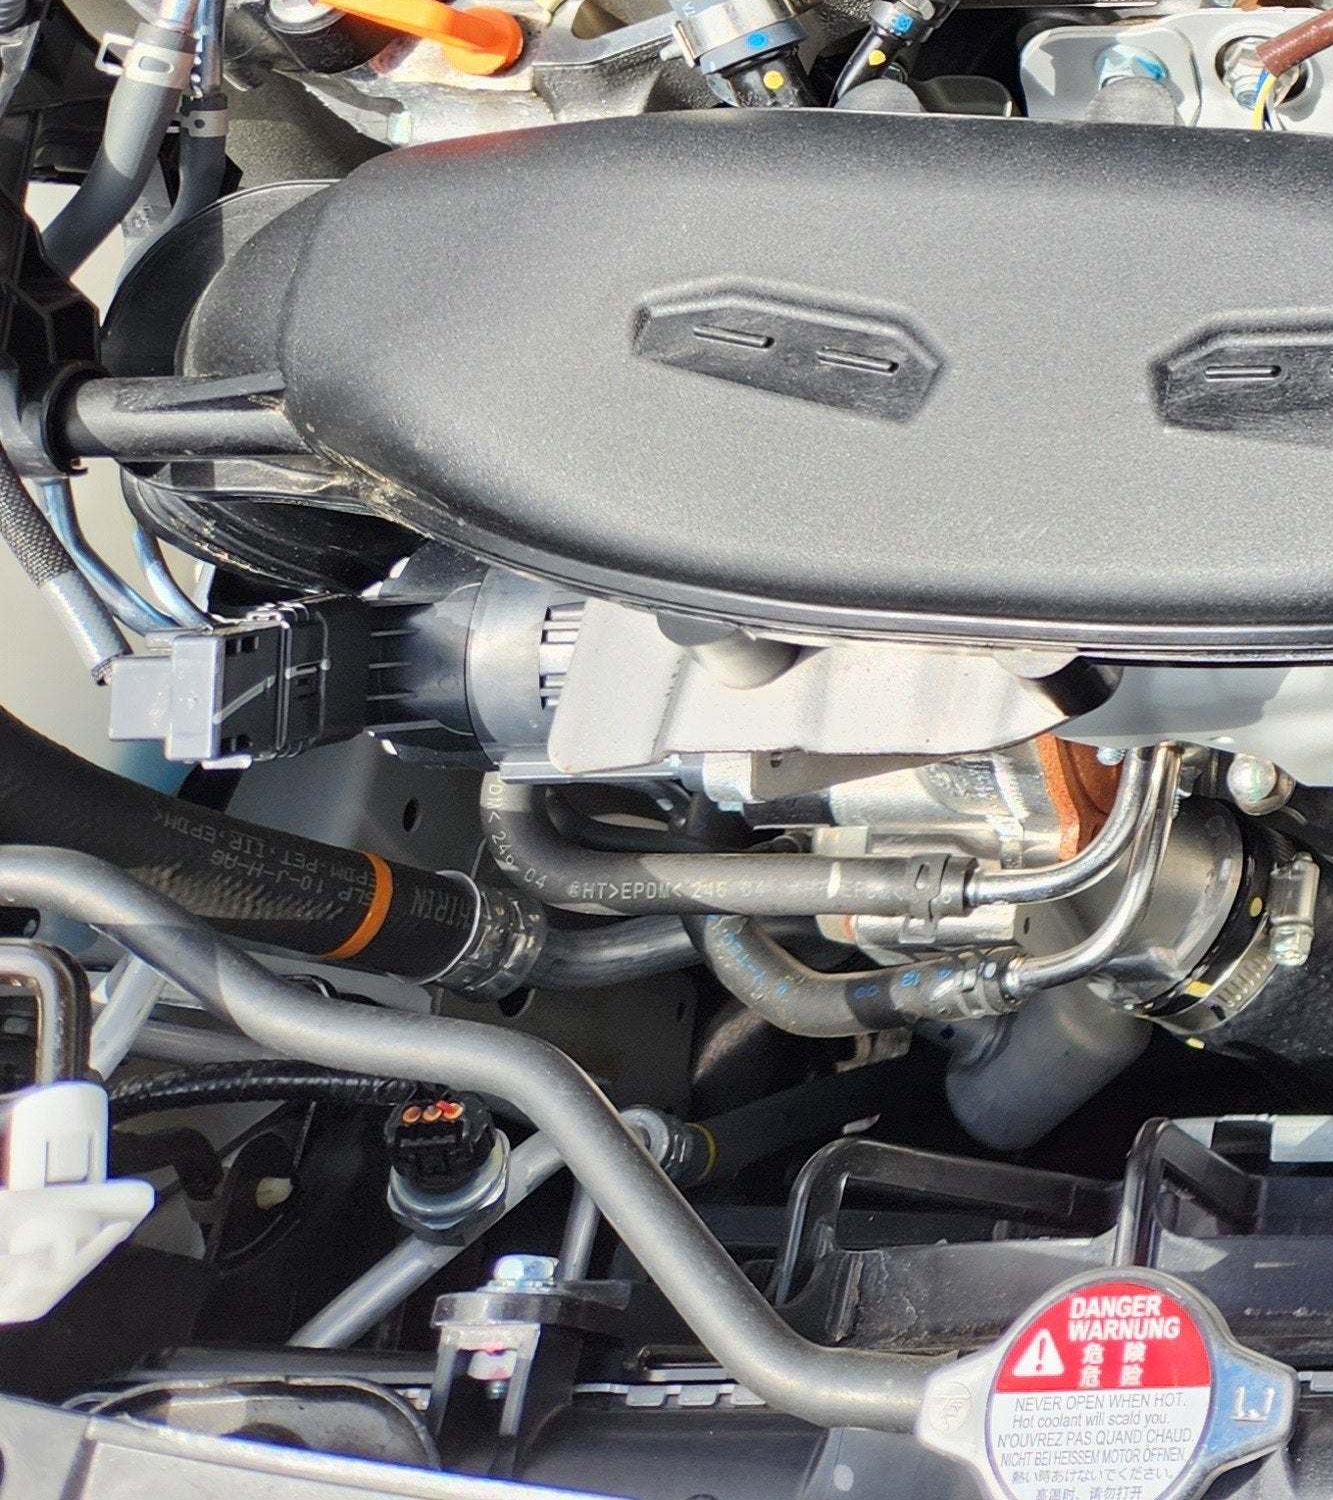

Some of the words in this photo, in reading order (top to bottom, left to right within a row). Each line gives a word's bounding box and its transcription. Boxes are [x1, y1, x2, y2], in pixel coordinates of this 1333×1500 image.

[1069, 1295, 1163, 1320] DANGER
[1067, 1316, 1181, 1343] WARNUNG
[1081, 1342, 1105, 1364] 危
[1079, 1364, 1103, 1388] 危
[1014, 1396, 1063, 1412] NEVER
[1065, 1394, 1105, 1410] OPEN
[1109, 1393, 1152, 1409] WHEN
[1154, 1392, 1187, 1408] HOT.
[1012, 1414, 1034, 1430] Hot
[1037, 1412, 1082, 1429] coolant
[1085, 1411, 1105, 1427] will
[1107, 1410, 1141, 1426] scald
[1144, 1413, 1170, 1429] you.
[997, 1431, 1063, 1449] N'OUVREZ
[1066, 1431, 1092, 1446] PAS
[1095, 1429, 1143, 1445] QUAND
[1000, 1451, 1032, 1468] NICHT
[1034, 1450, 1052, 1467] BEI
[1054, 1449, 1101, 1466] HEISSEM
[1102, 1448, 1141, 1464] MOTOR
